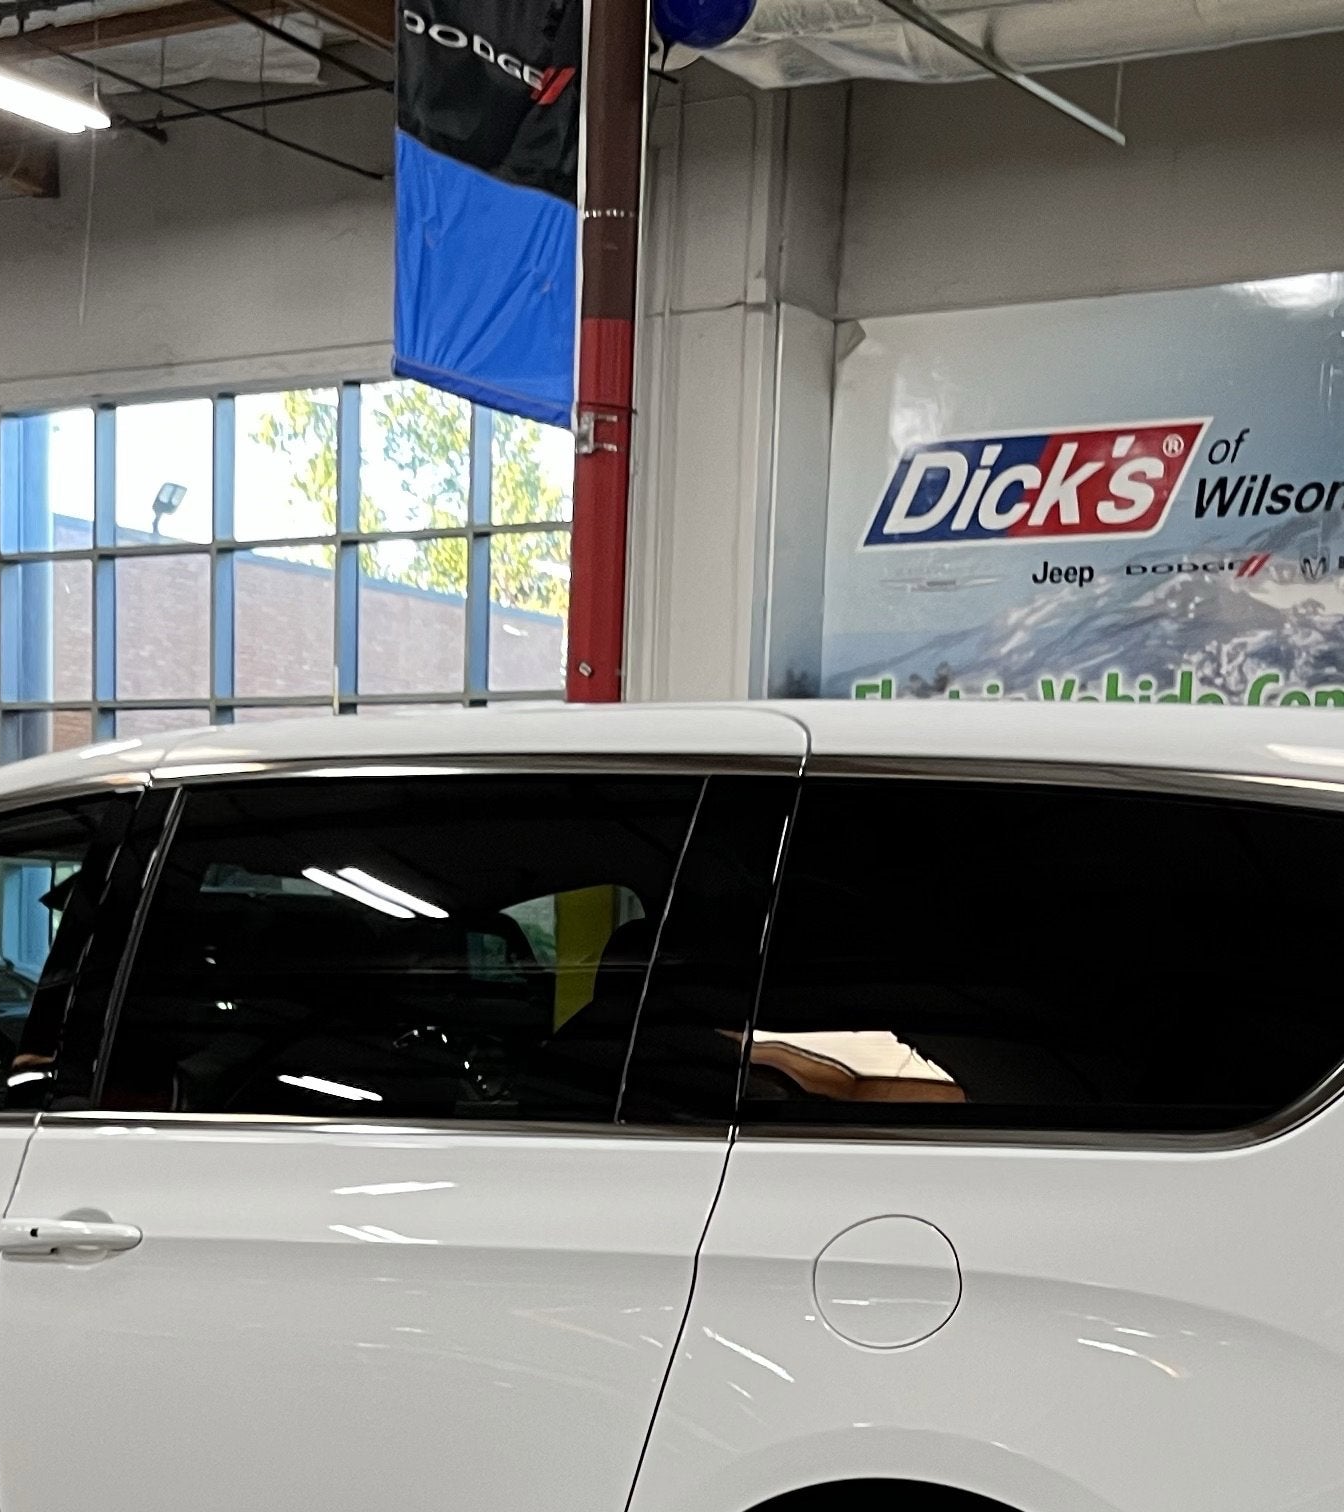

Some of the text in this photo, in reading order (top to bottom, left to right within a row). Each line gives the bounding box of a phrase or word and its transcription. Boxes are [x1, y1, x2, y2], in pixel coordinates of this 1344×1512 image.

[403, 9, 545, 91] DODGE
[1207, 427, 1251, 465] of
[882, 434, 1165, 535] Dick's
[1031, 560, 1095, 588] Jeep
